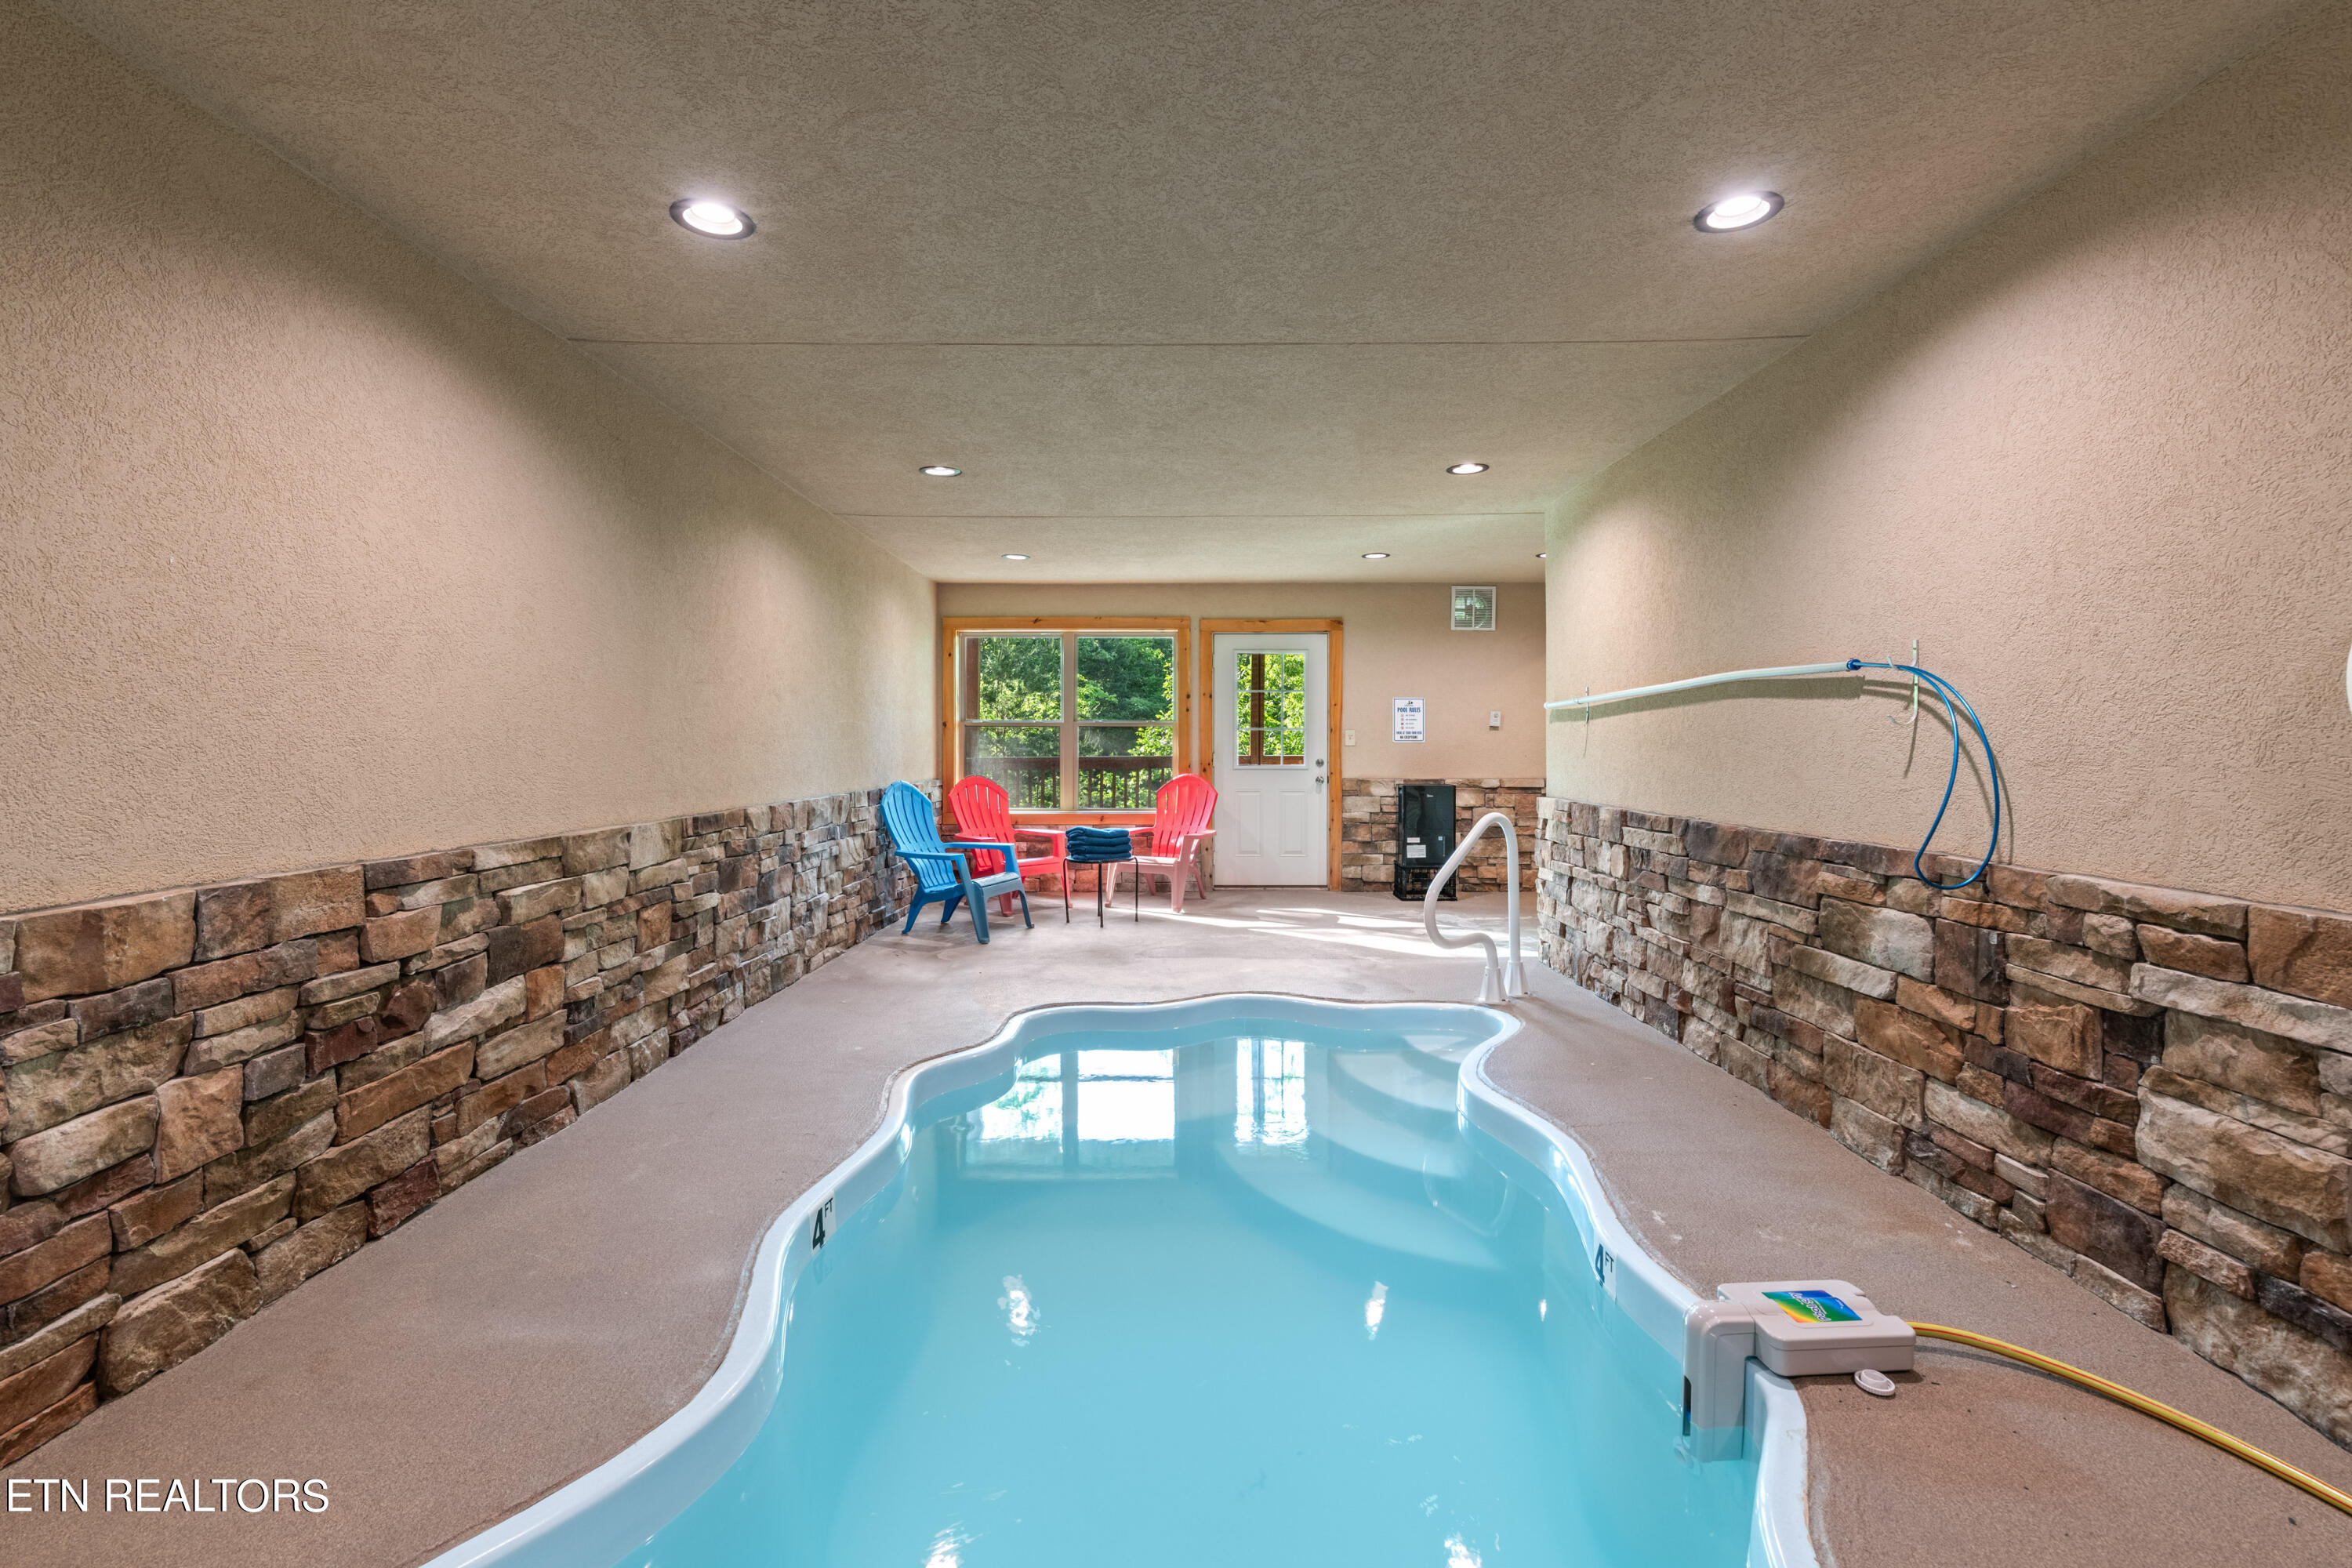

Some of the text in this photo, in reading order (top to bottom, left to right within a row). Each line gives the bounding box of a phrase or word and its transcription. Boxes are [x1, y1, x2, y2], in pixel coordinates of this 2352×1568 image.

[812, 1197, 833, 1250] 4 FT
[1595, 1243, 1615, 1287] 4 FT
